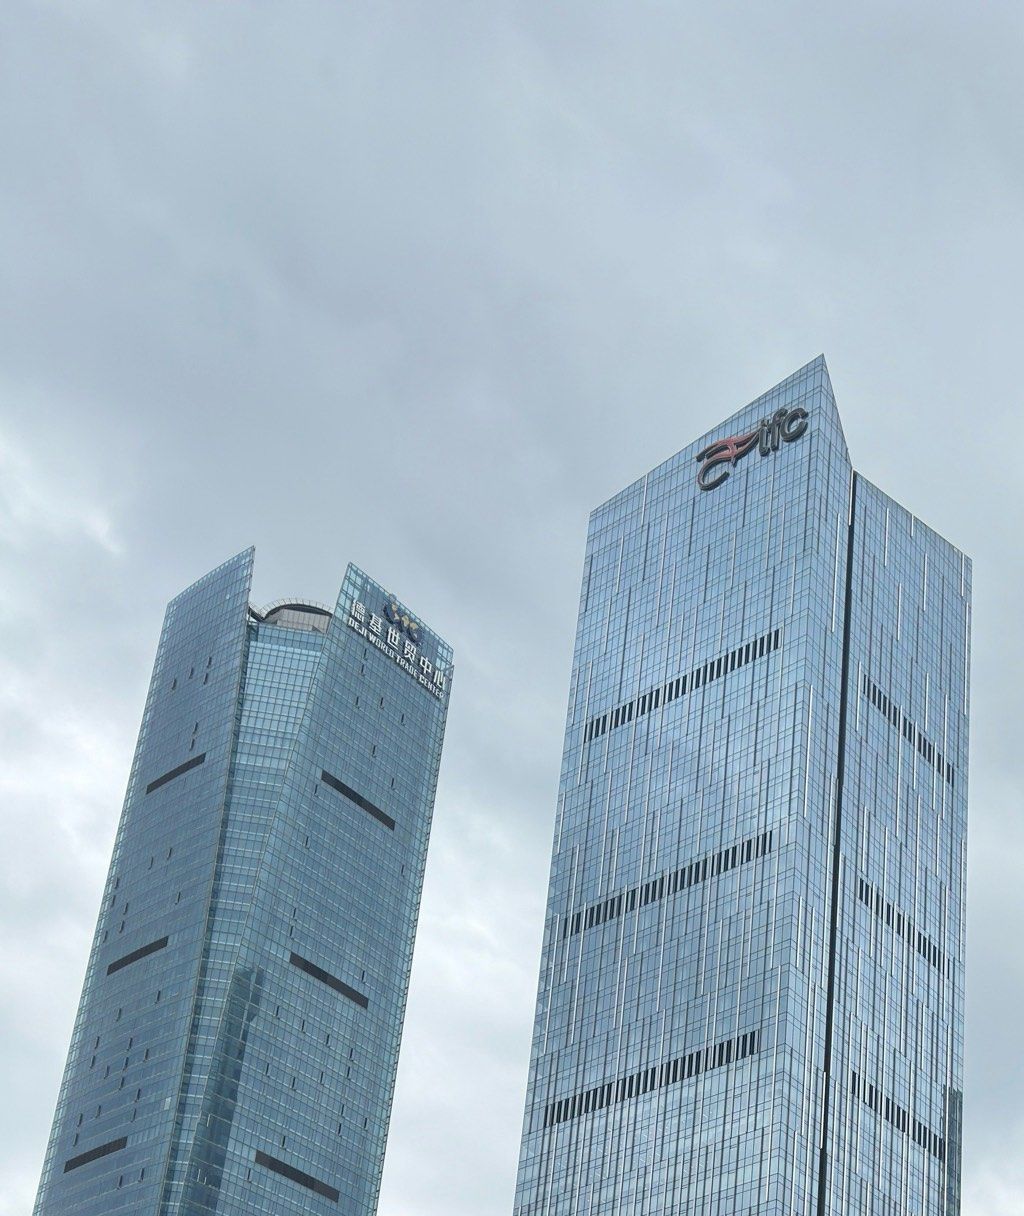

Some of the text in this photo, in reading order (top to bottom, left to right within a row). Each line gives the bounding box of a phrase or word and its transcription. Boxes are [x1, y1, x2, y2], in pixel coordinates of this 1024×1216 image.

[348, 617, 445, 699] DEJI WORLD TRADE CENTER
[350, 599, 447, 690] 德基世贸中心
